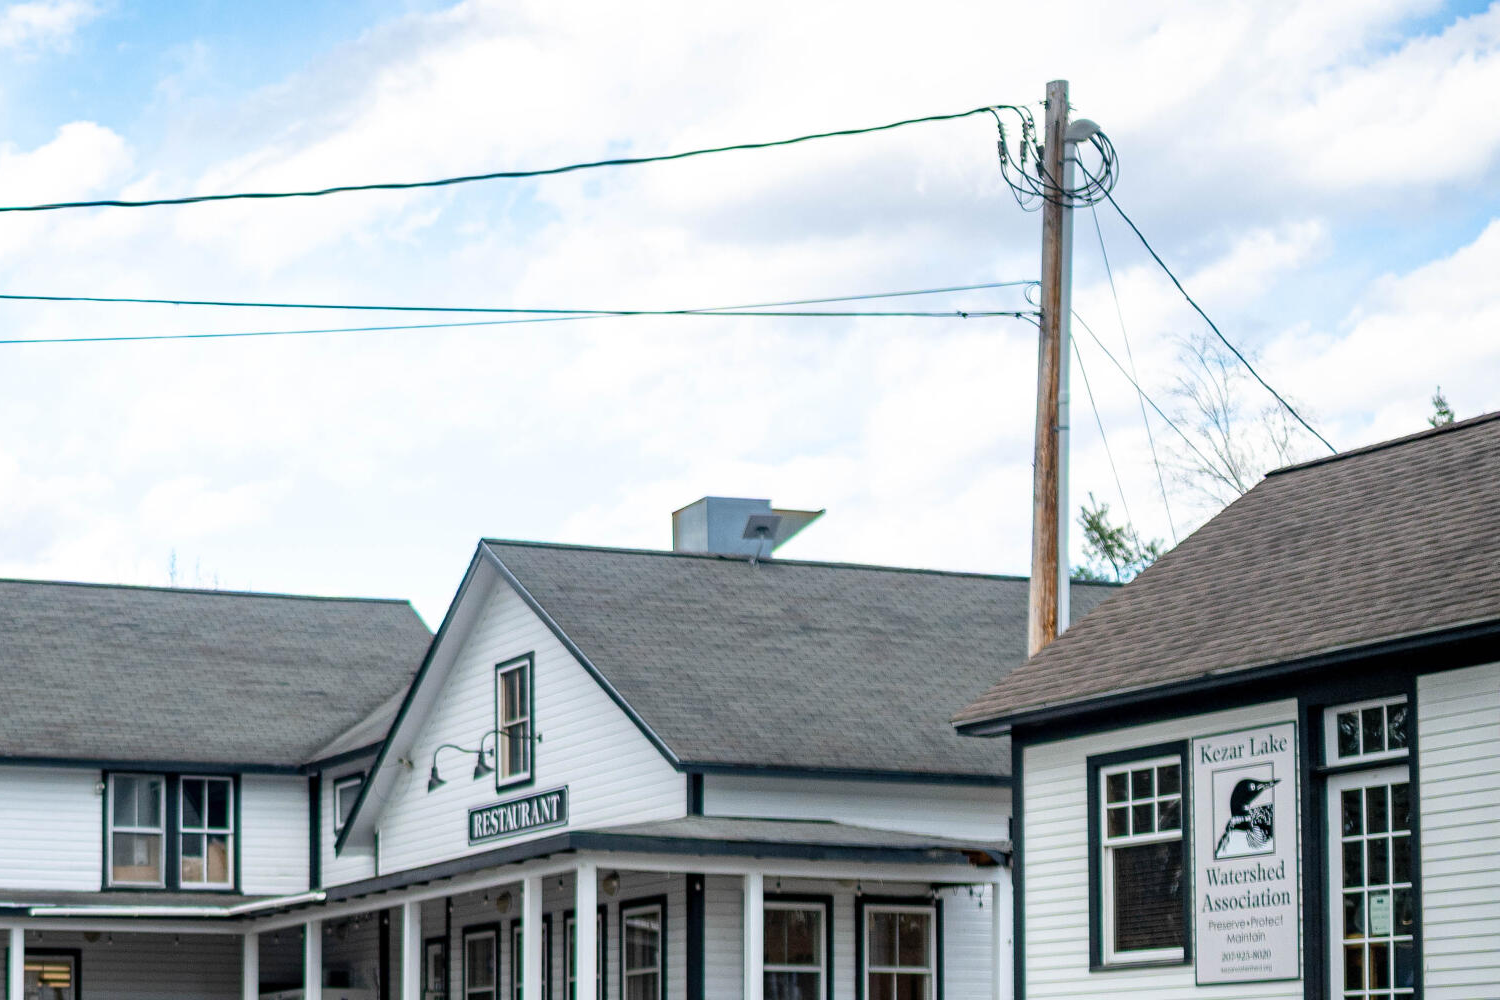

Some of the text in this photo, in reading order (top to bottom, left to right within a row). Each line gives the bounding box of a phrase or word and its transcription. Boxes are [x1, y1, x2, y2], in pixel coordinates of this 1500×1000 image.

[1201, 733, 1287, 764] Kezar Lake
[474, 794, 560, 838] RESTAURANT
[1206, 860, 1286, 887] Watershed
[1202, 888, 1292, 914] Association
[1208, 914, 1283, 931] Preserve Protect
[1227, 931, 1266, 944] Maintain
